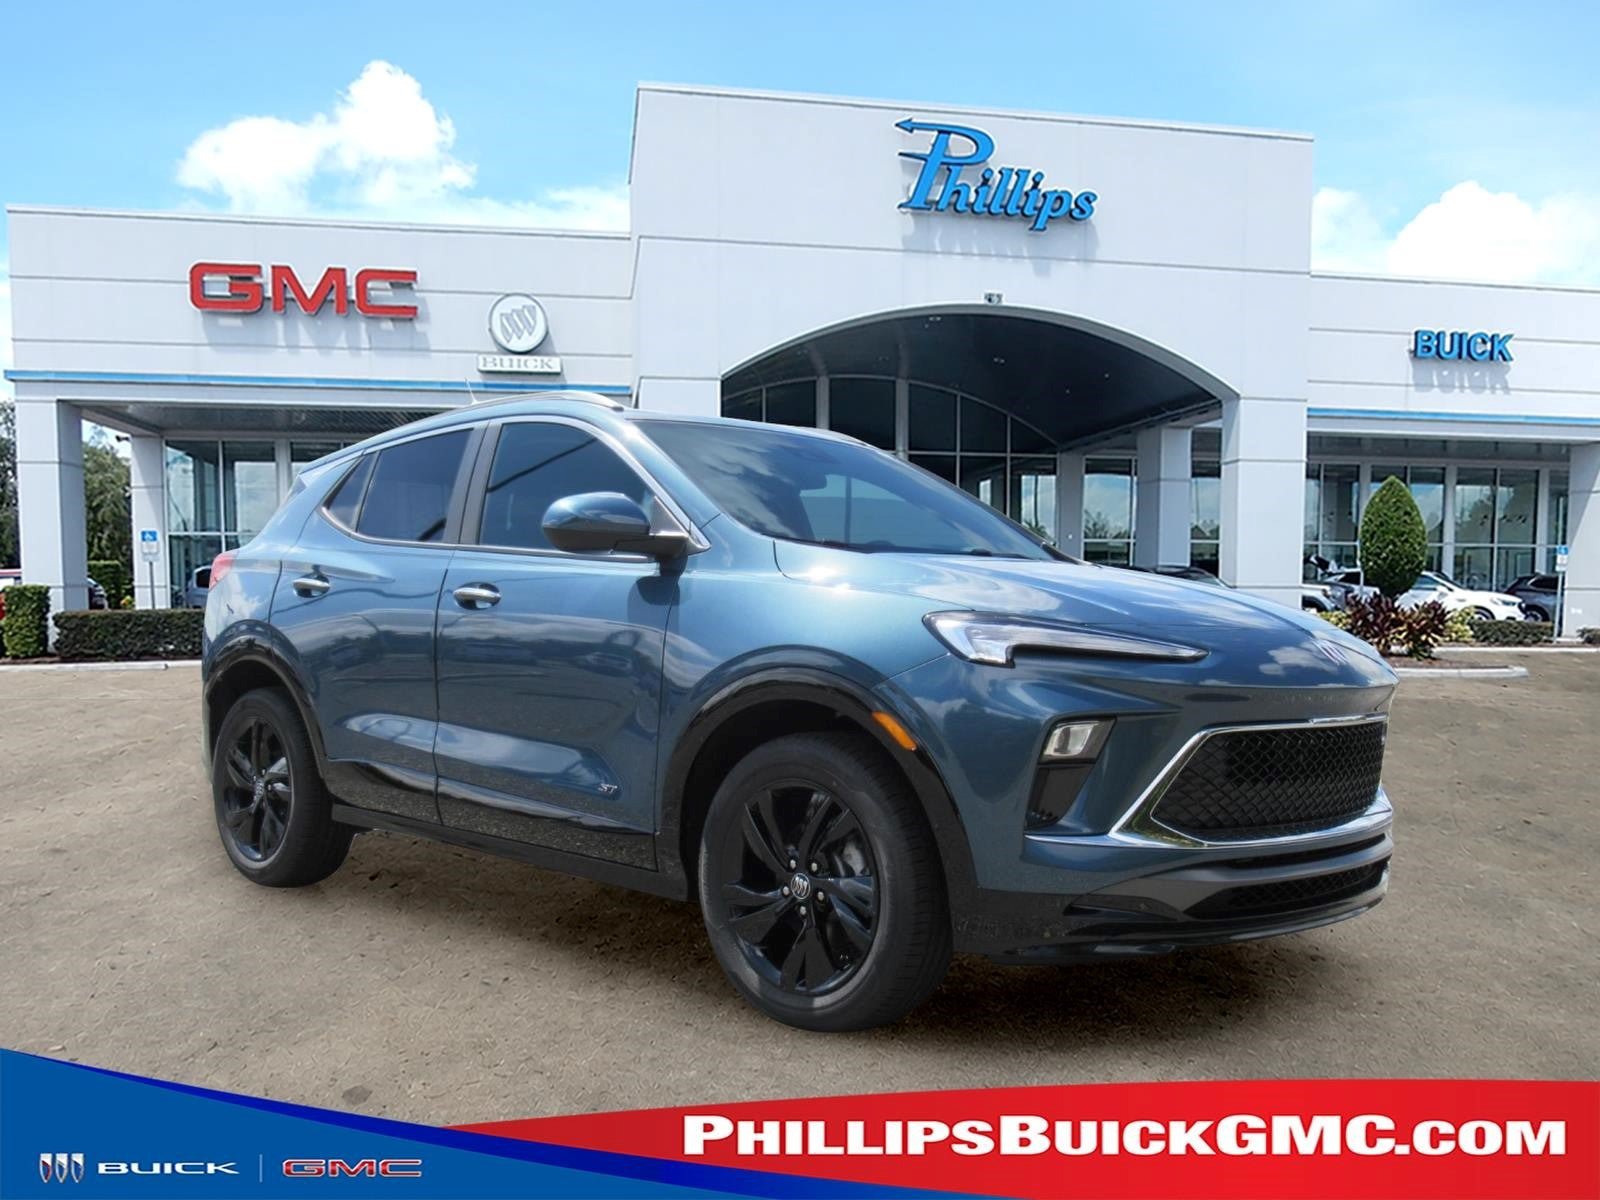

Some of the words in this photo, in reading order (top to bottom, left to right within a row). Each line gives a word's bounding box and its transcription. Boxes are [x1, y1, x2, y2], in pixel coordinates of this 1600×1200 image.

[895, 118, 1098, 231] Phillips
[189, 262, 418, 320] GMC
[482, 356, 553, 370] BUICK
[1412, 328, 1513, 362] BUICK
